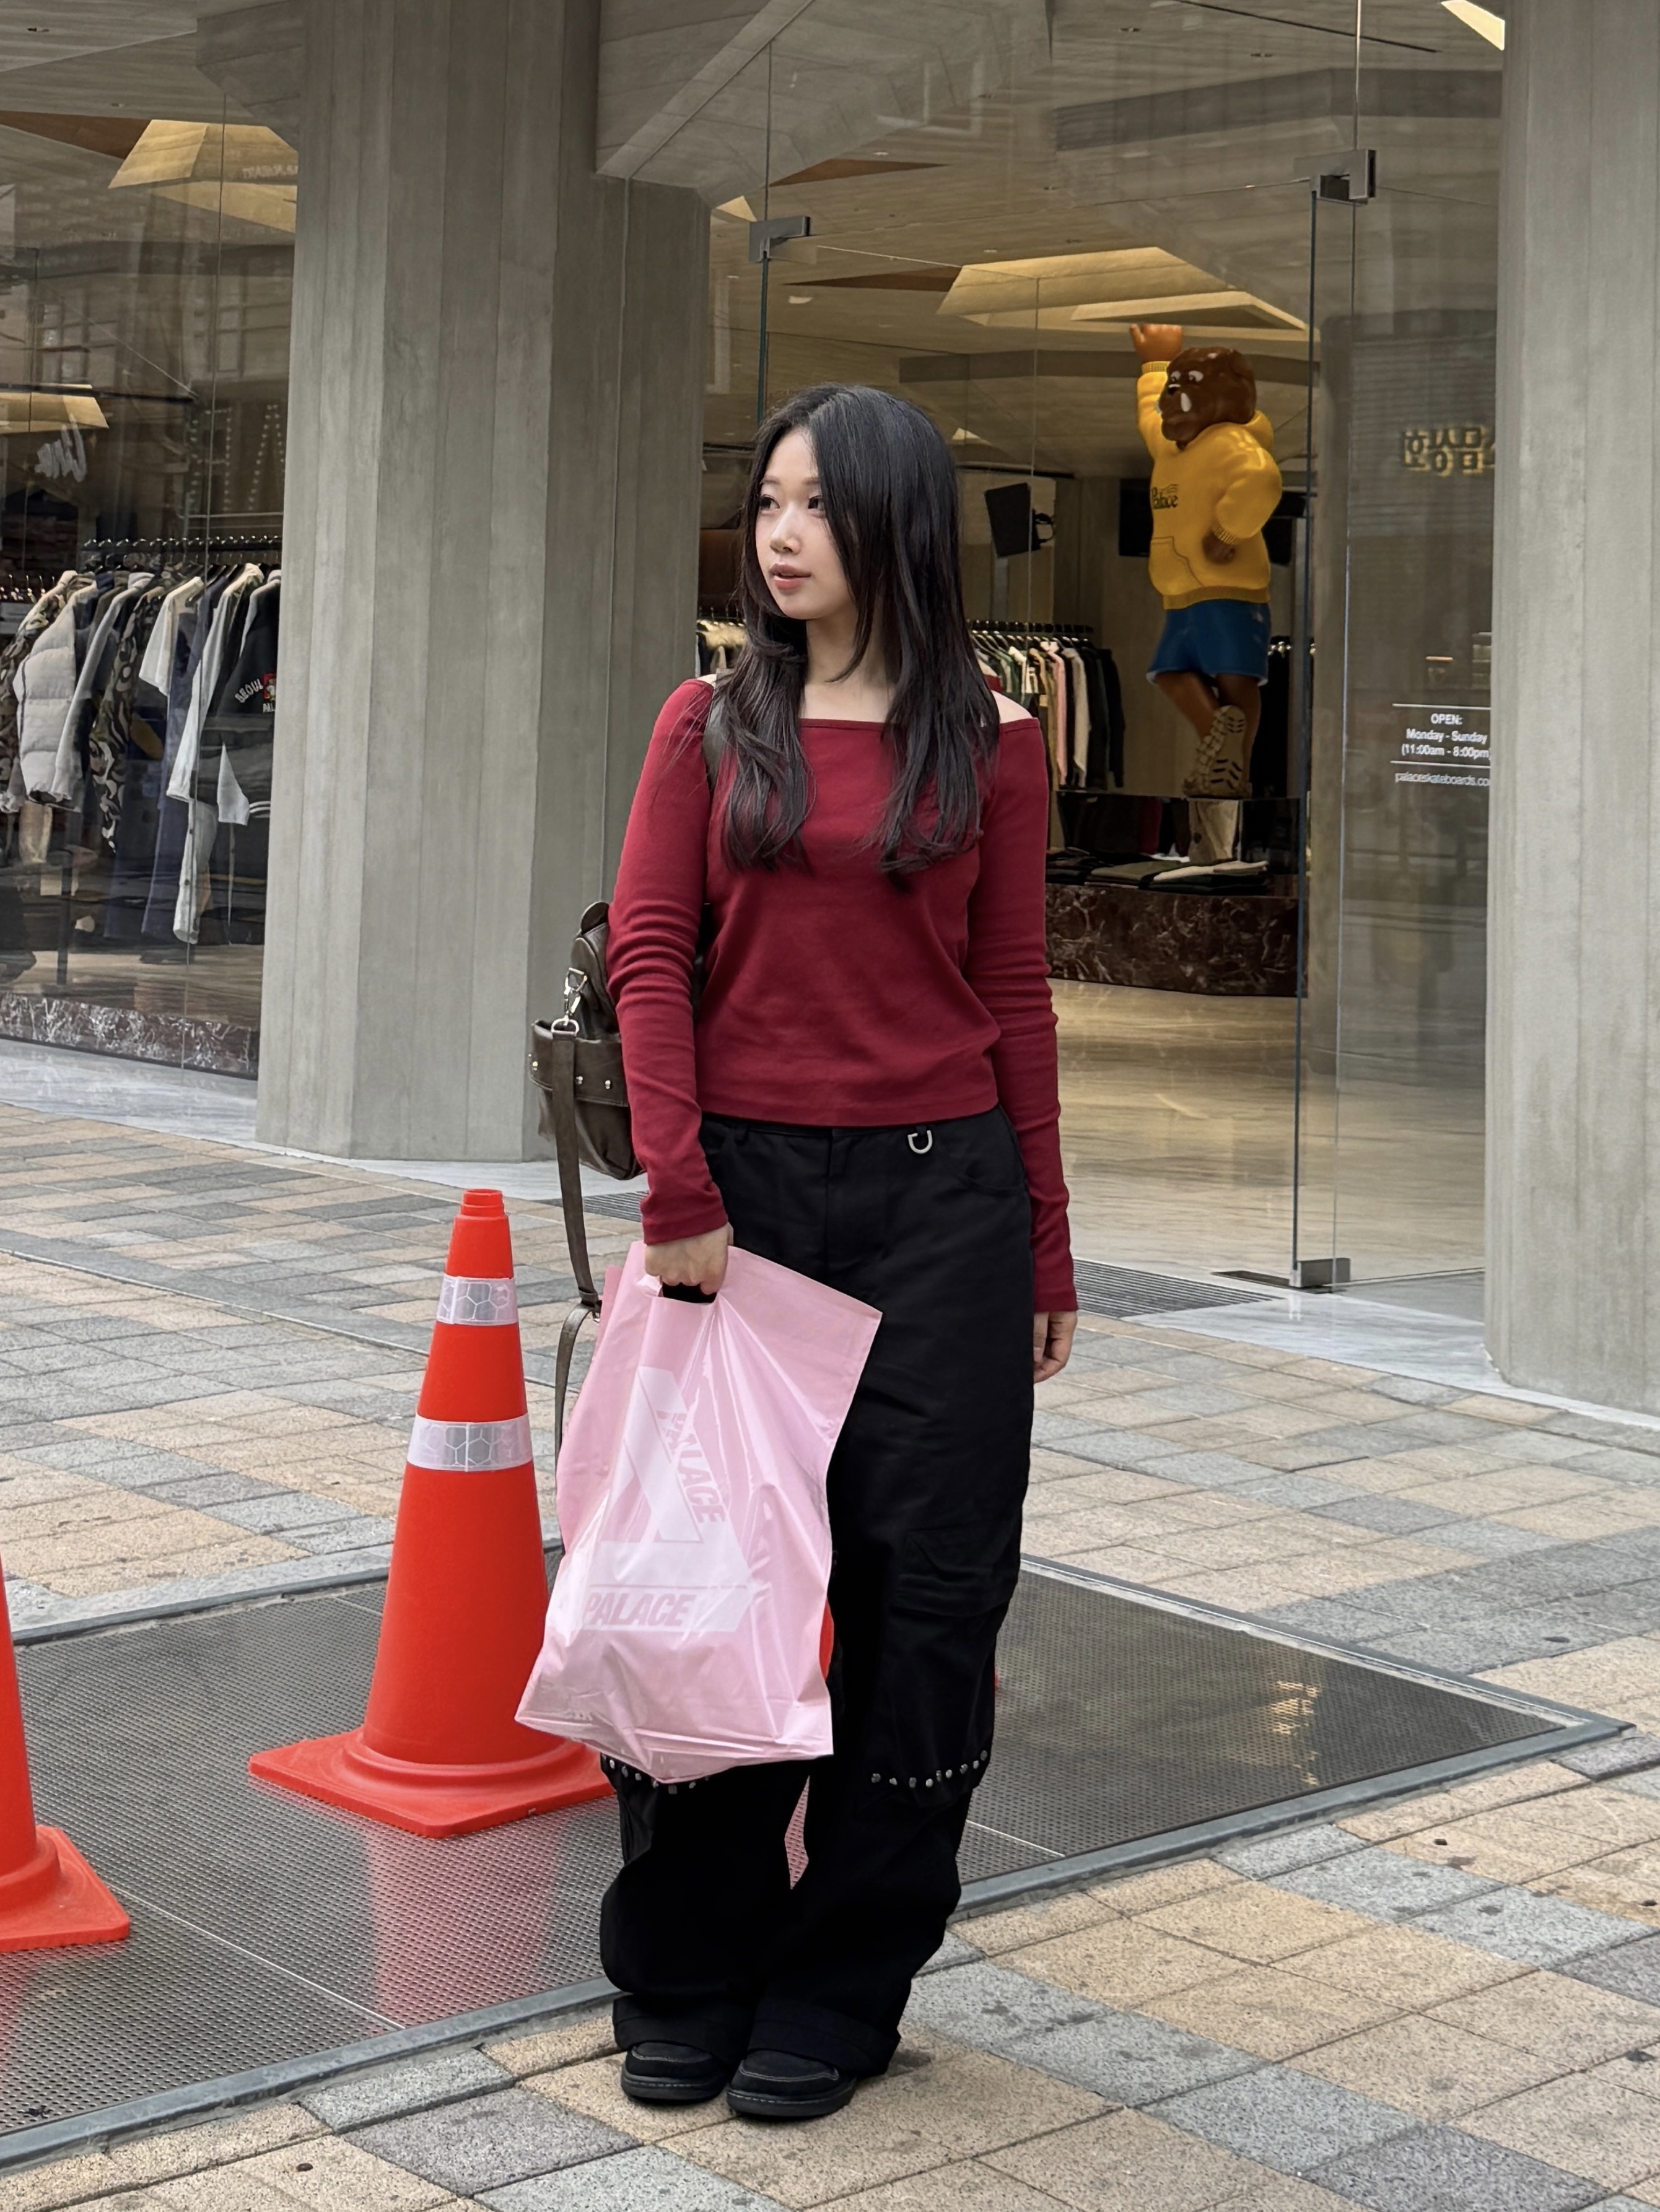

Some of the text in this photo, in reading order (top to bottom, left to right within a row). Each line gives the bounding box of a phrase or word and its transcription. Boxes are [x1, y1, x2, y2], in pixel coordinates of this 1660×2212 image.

[1151, 486, 1179, 510] Palace
[1430, 713, 1463, 725] OPEN:
[1405, 728, 1444, 742] Monday
[1451, 730, 1488, 745] Sunday
[1401, 743, 1445, 756] (11:00am
[1395, 772, 1490, 785] palaceskateboards.co
[584, 1592, 697, 1627] PALACE
